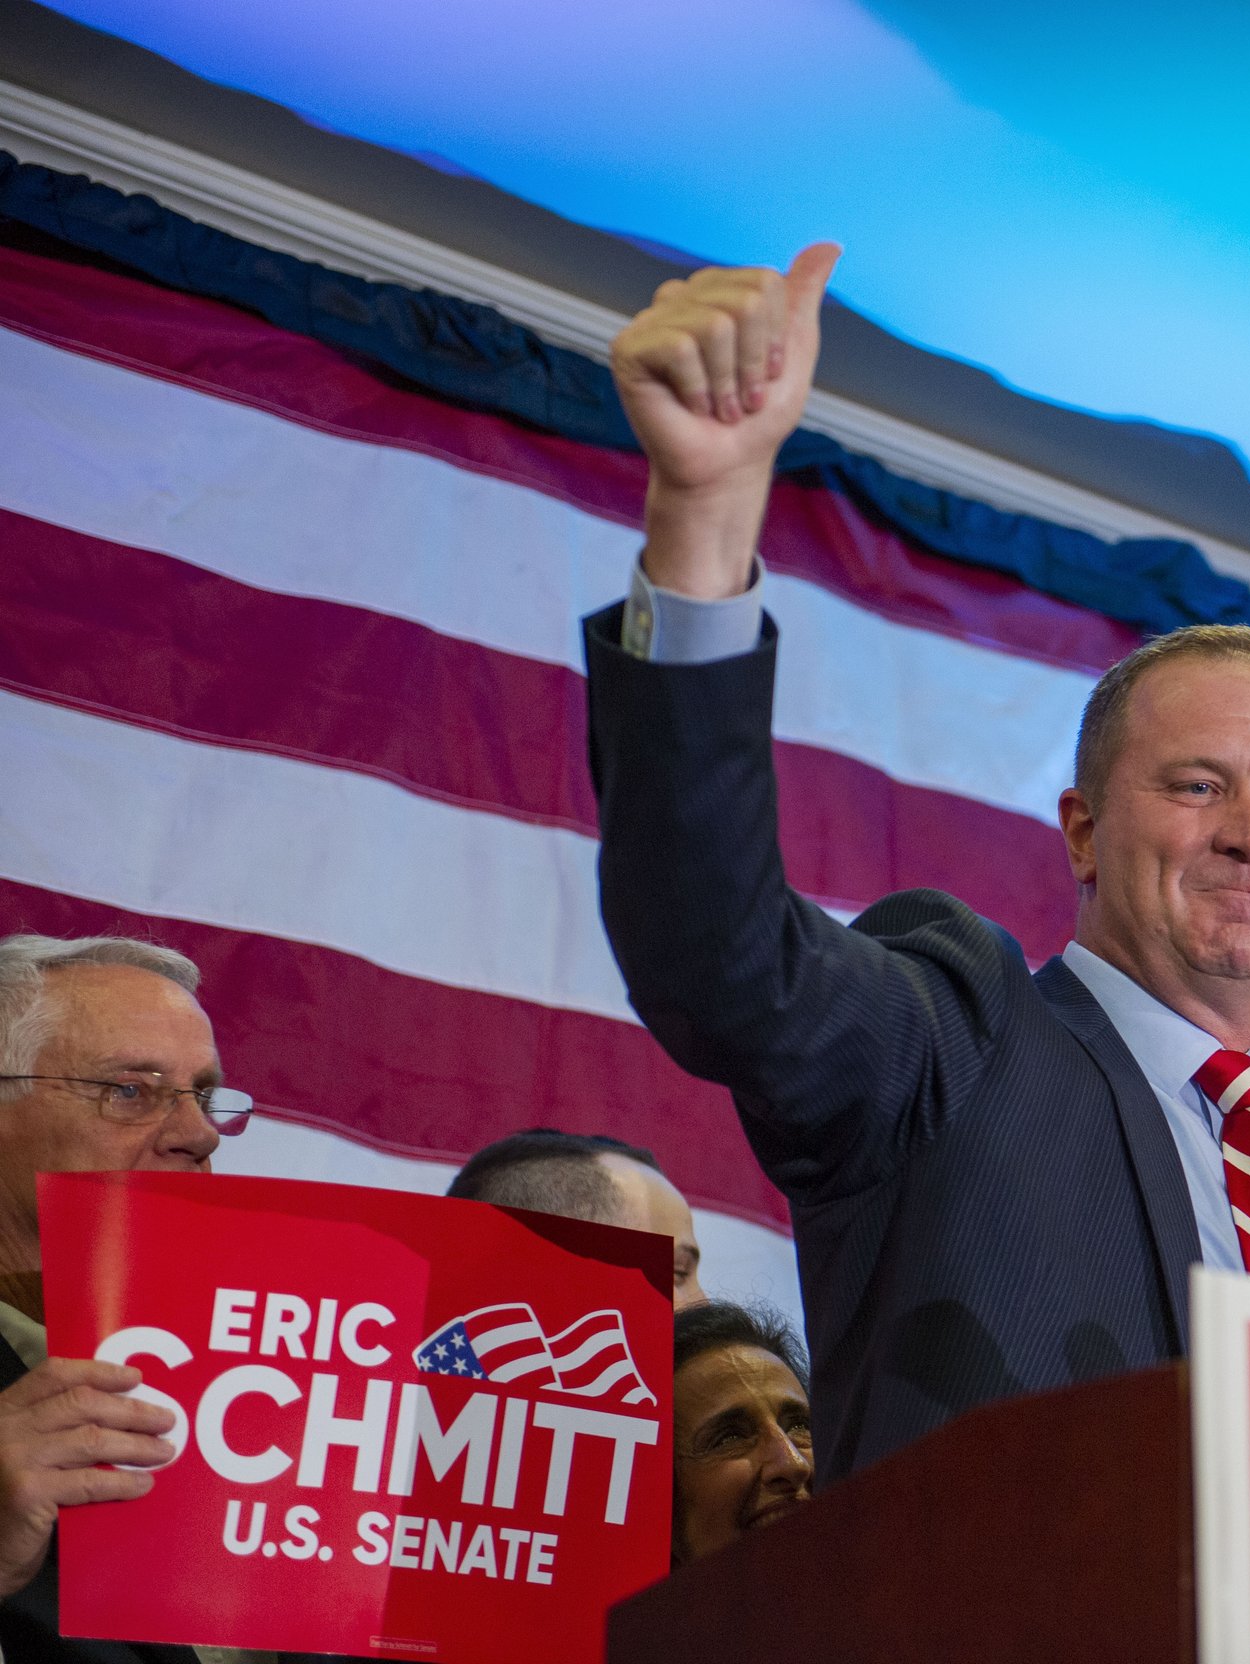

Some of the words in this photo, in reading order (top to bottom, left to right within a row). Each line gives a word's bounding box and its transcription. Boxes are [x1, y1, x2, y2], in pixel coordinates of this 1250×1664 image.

[208, 1287, 397, 1367] ERIC
[222, 1500, 334, 1562] U.S.
[352, 1510, 558, 1585] SENATE
